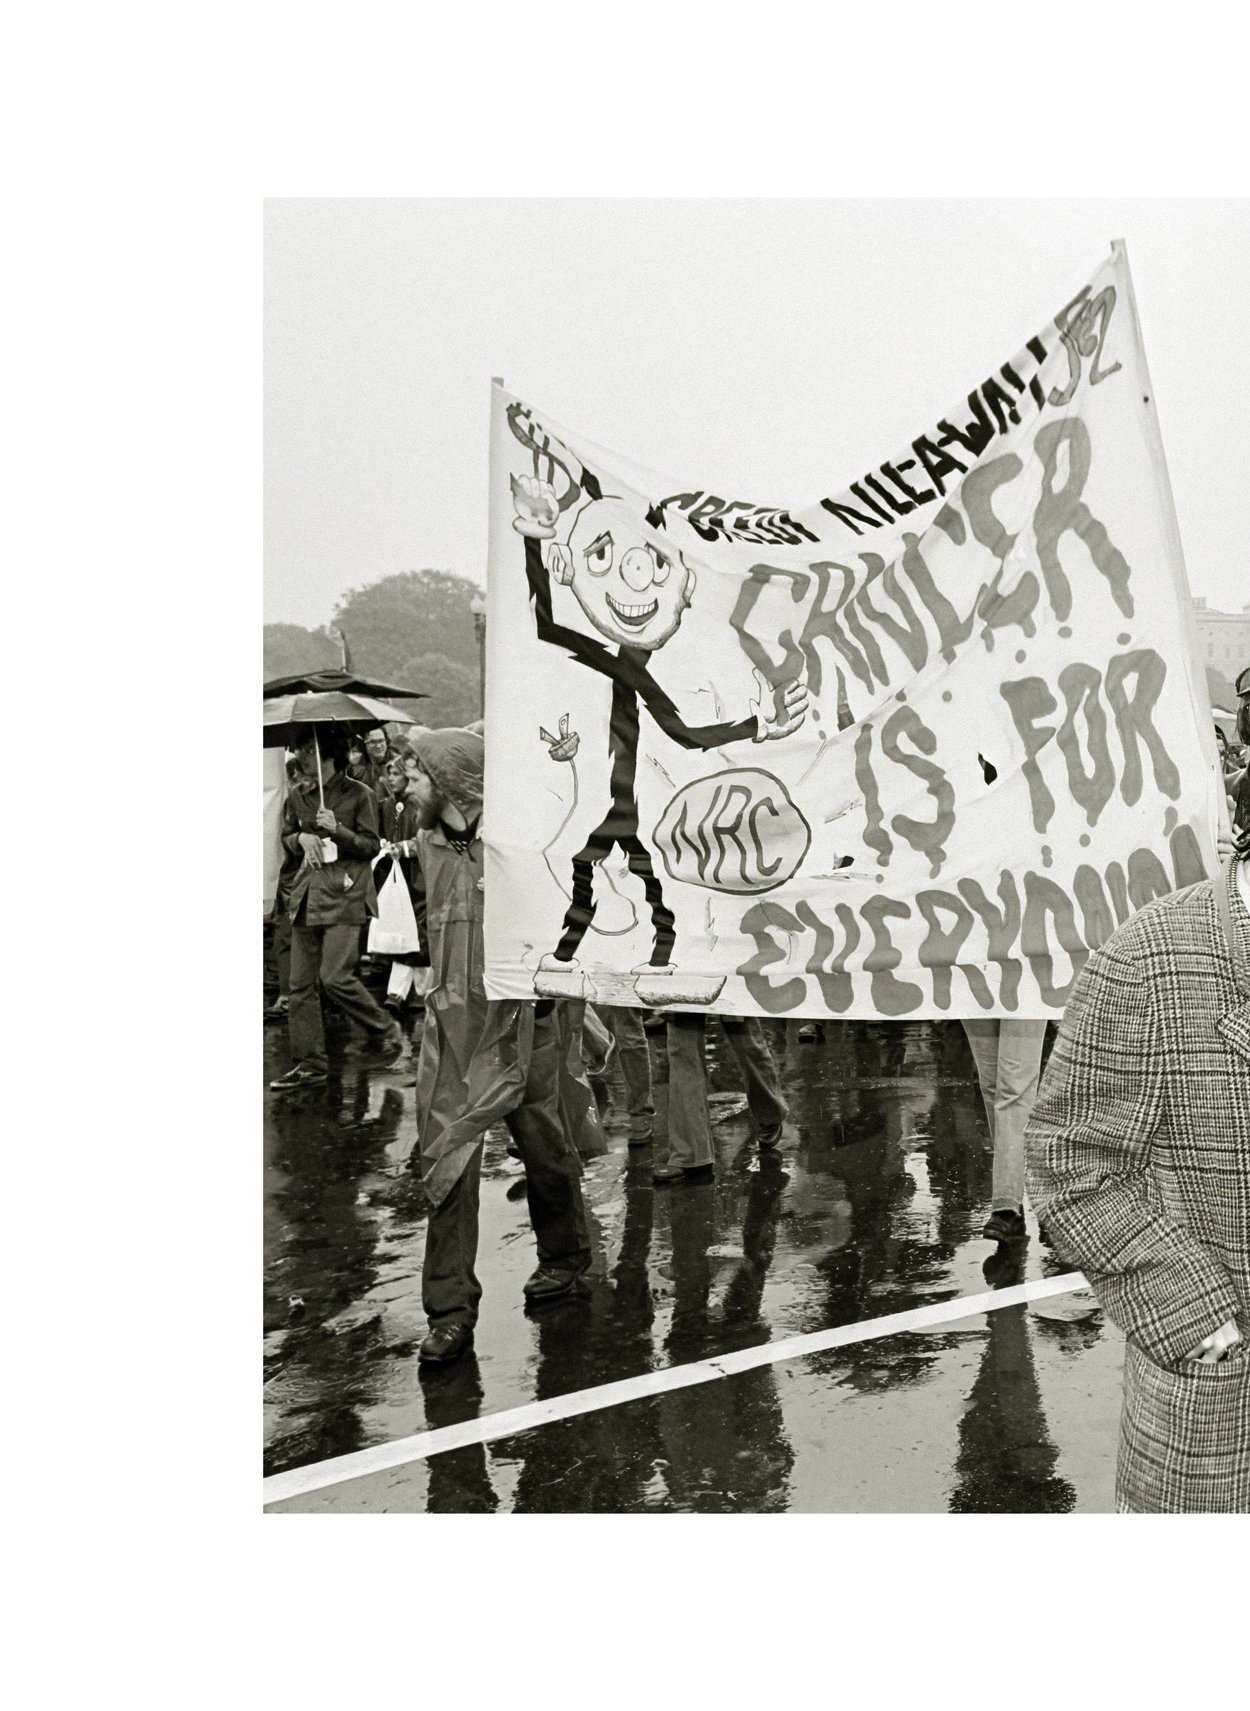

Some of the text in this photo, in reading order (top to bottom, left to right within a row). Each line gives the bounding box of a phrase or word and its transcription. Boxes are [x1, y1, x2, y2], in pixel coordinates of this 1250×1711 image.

[728, 416, 1136, 700] CANCER
[670, 783, 784, 886] NRC
[853, 648, 1182, 874] IS FOR
